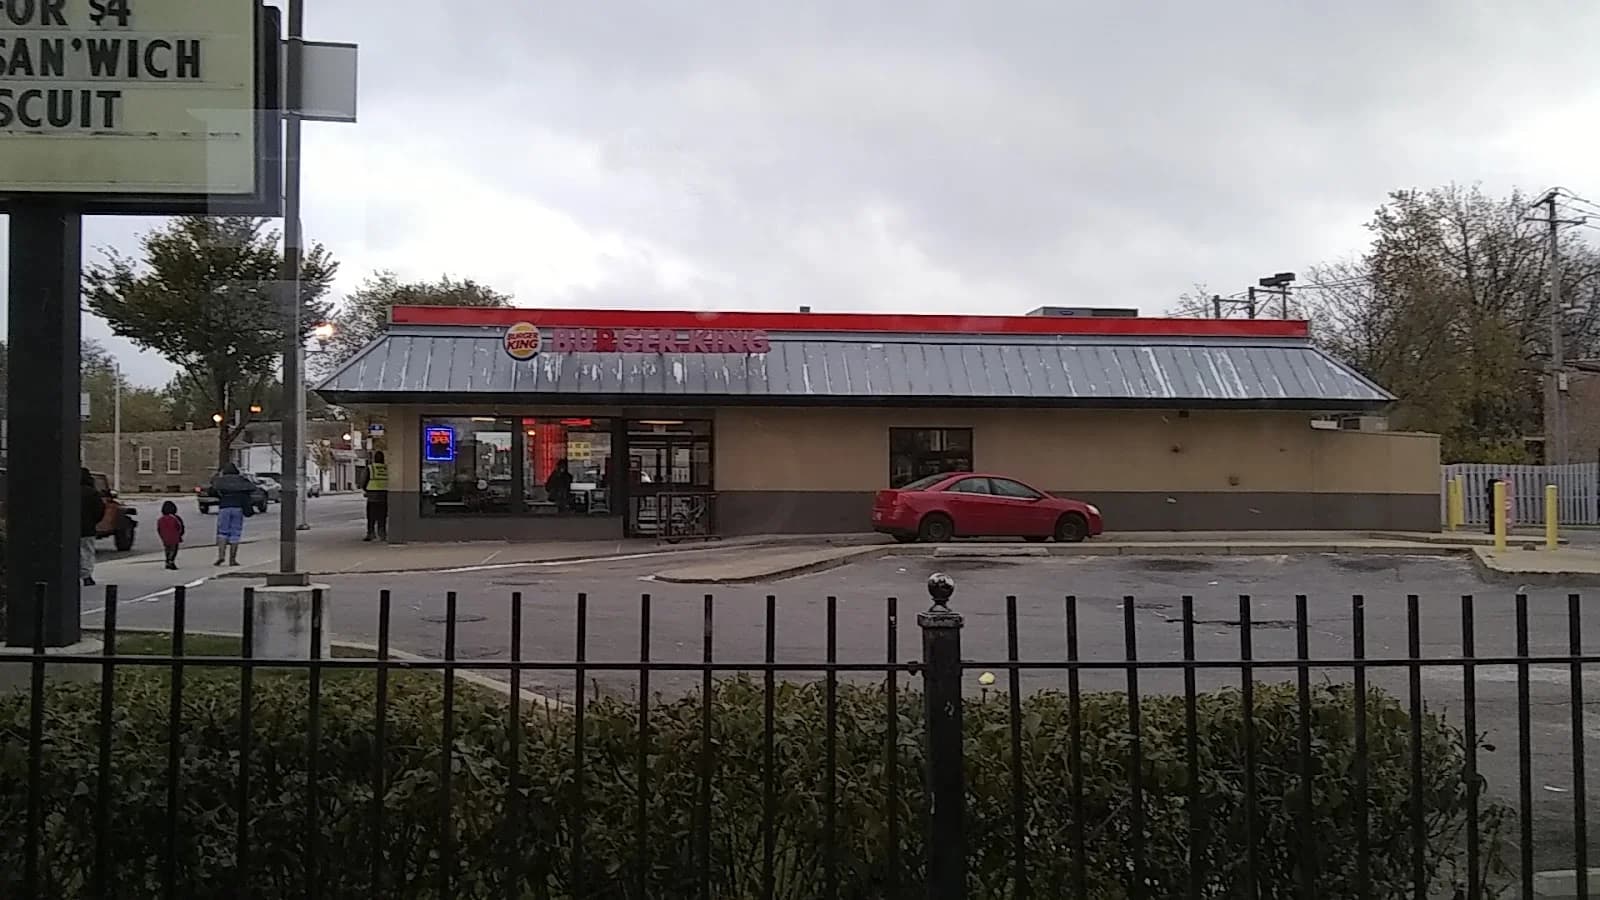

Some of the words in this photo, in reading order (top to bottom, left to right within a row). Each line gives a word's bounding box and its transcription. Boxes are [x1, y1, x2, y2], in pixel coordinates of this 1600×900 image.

[0, 0, 68, 26] OR
[88, 0, 131, 26] $4
[0, 37, 200, 78] AN'WICH
[507, 339, 538, 350] KING
[508, 332, 539, 340] BURGER
[552, 328, 679, 353] BURGER
[688, 329, 769, 353] KING
